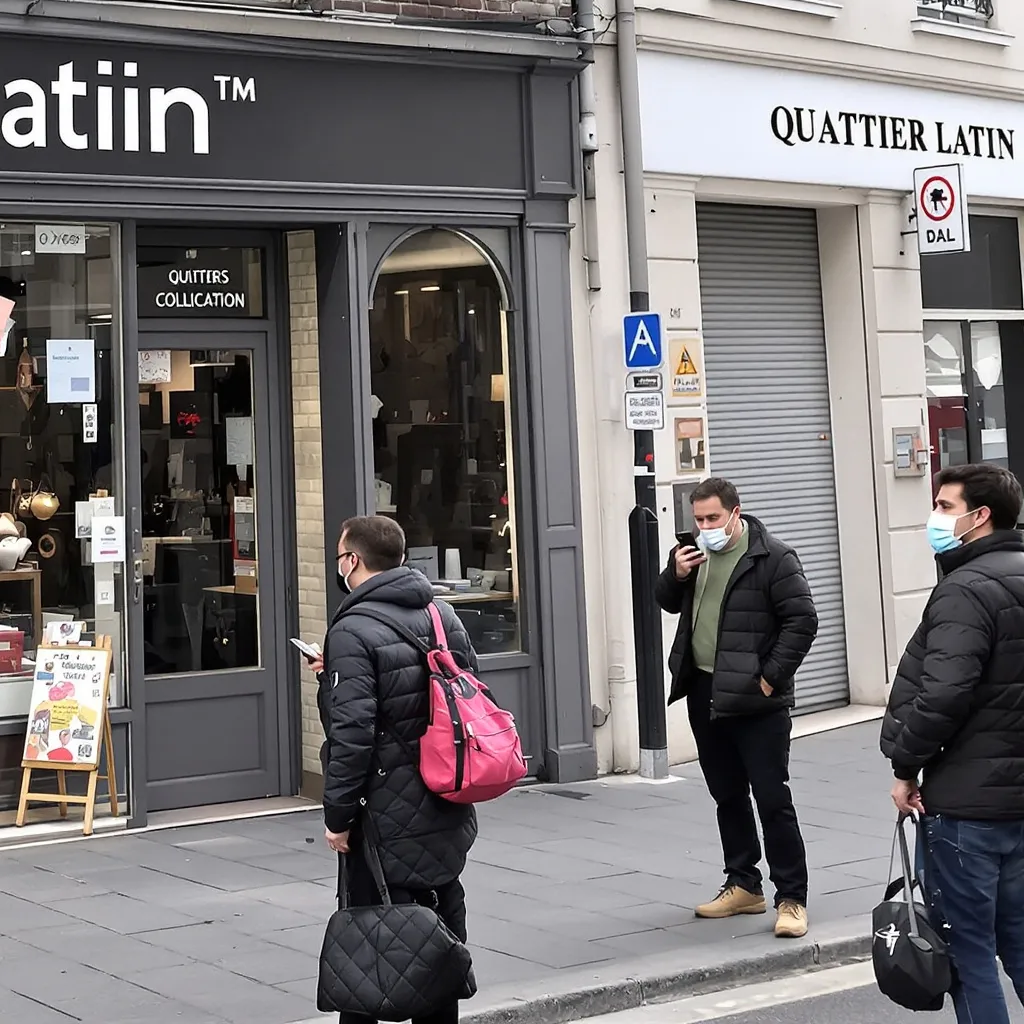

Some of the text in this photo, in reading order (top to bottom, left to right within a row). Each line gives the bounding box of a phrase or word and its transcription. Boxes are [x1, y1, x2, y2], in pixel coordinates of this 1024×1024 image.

[771, 105, 1015, 160] QUATTIER LATIN
[926, 228, 956, 244] DAL
[155, 292, 245, 308] COLLICATION
